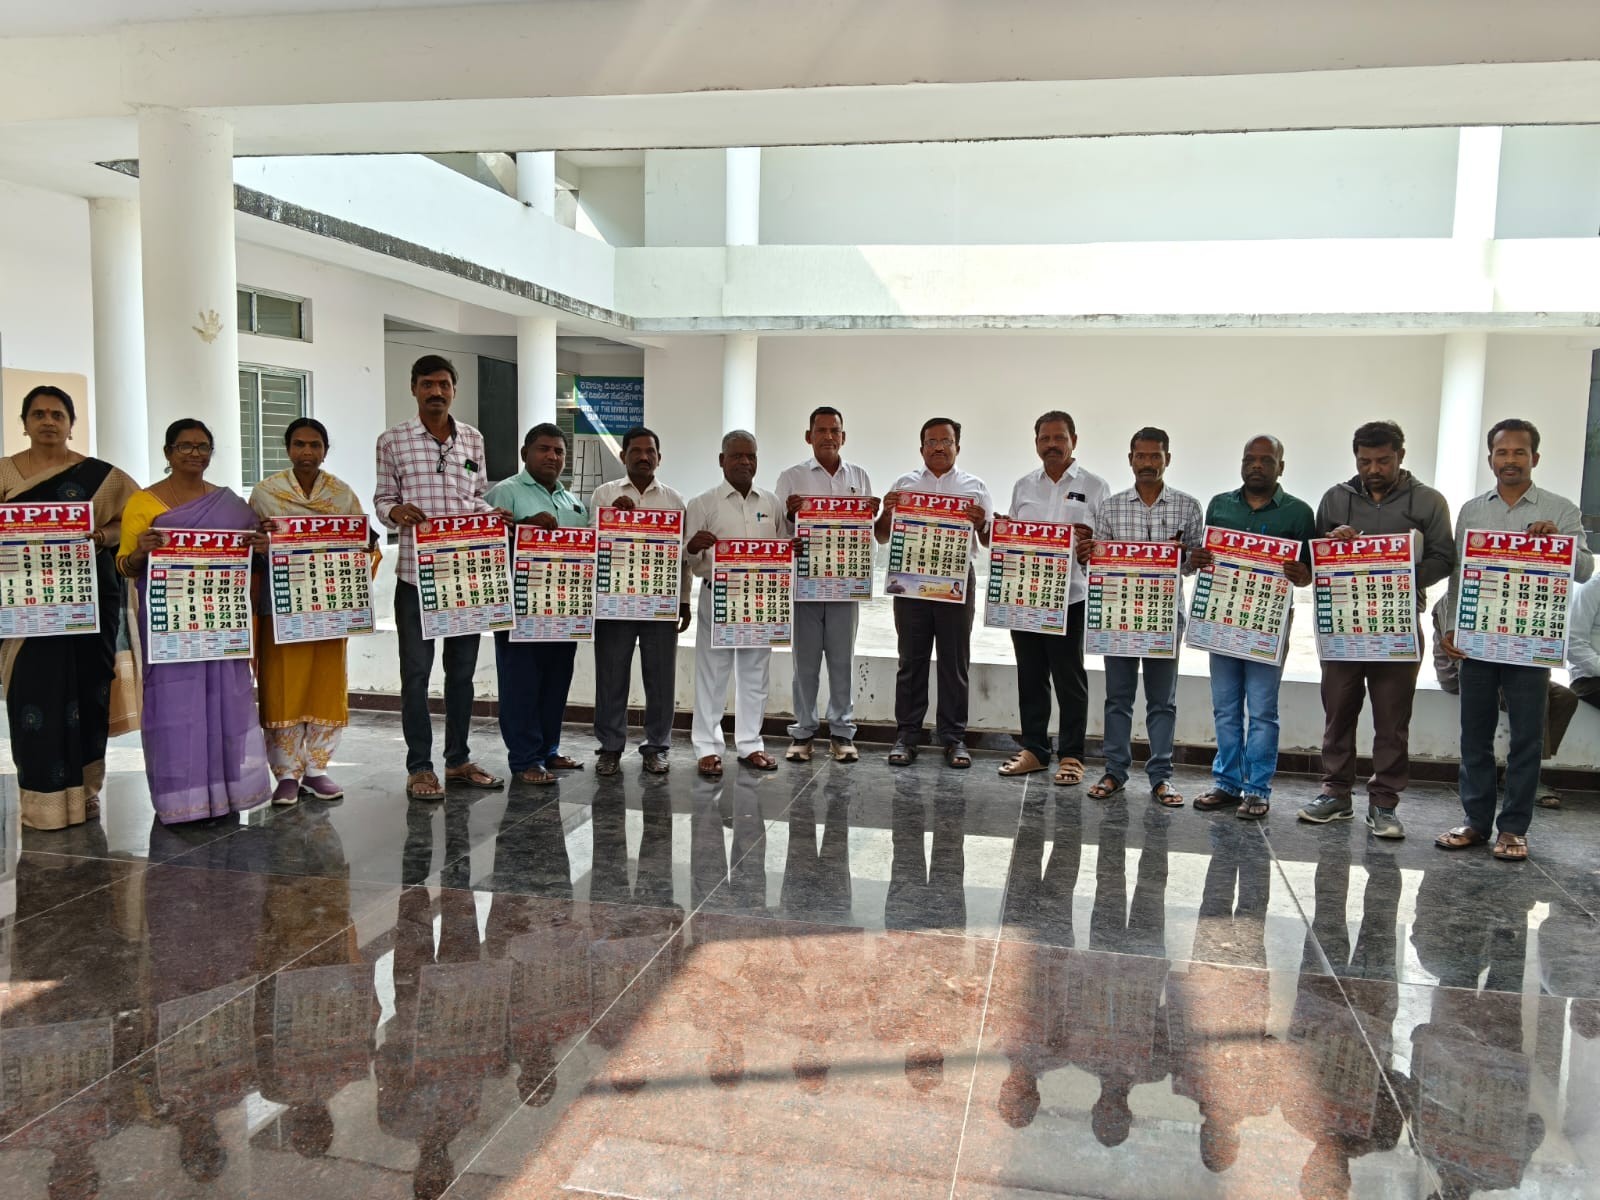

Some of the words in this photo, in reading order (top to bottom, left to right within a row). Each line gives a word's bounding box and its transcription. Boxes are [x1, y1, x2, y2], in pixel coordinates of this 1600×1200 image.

[813, 499, 869, 510] TPTF
[912, 495, 970, 510] TPTF
[0, 507, 86, 522] TPTF
[615, 511, 677, 524] TPTF
[290, 518, 363, 533] TPTF
[434, 516, 500, 531] TPTF
[534, 529, 593, 543] TPTF
[1008, 523, 1068, 538] TPTF
[172, 533, 246, 548] TPTF
[1224, 533, 1295, 555] TPTF
[1331, 538, 1406, 554] TPTF
[1488, 534, 1569, 553] TPTF
[731, 542, 789, 554] TPTF
[1107, 544, 1175, 558] TPTF
[76, 551, 90, 559] 26
[43, 595, 54, 603] 17
[470, 597, 479, 605] 17
[1534, 593, 1548, 601] 20
[327, 601, 336, 609] 17
[205, 620, 214, 629] 17
[1253, 614, 1265, 622] 23
[1268, 618, 1281, 626] 30
[1532, 619, 1545, 628] 23
[1549, 622, 1564, 630] 30
[1252, 623, 1263, 631] 24
[1516, 626, 1526, 634] 17
